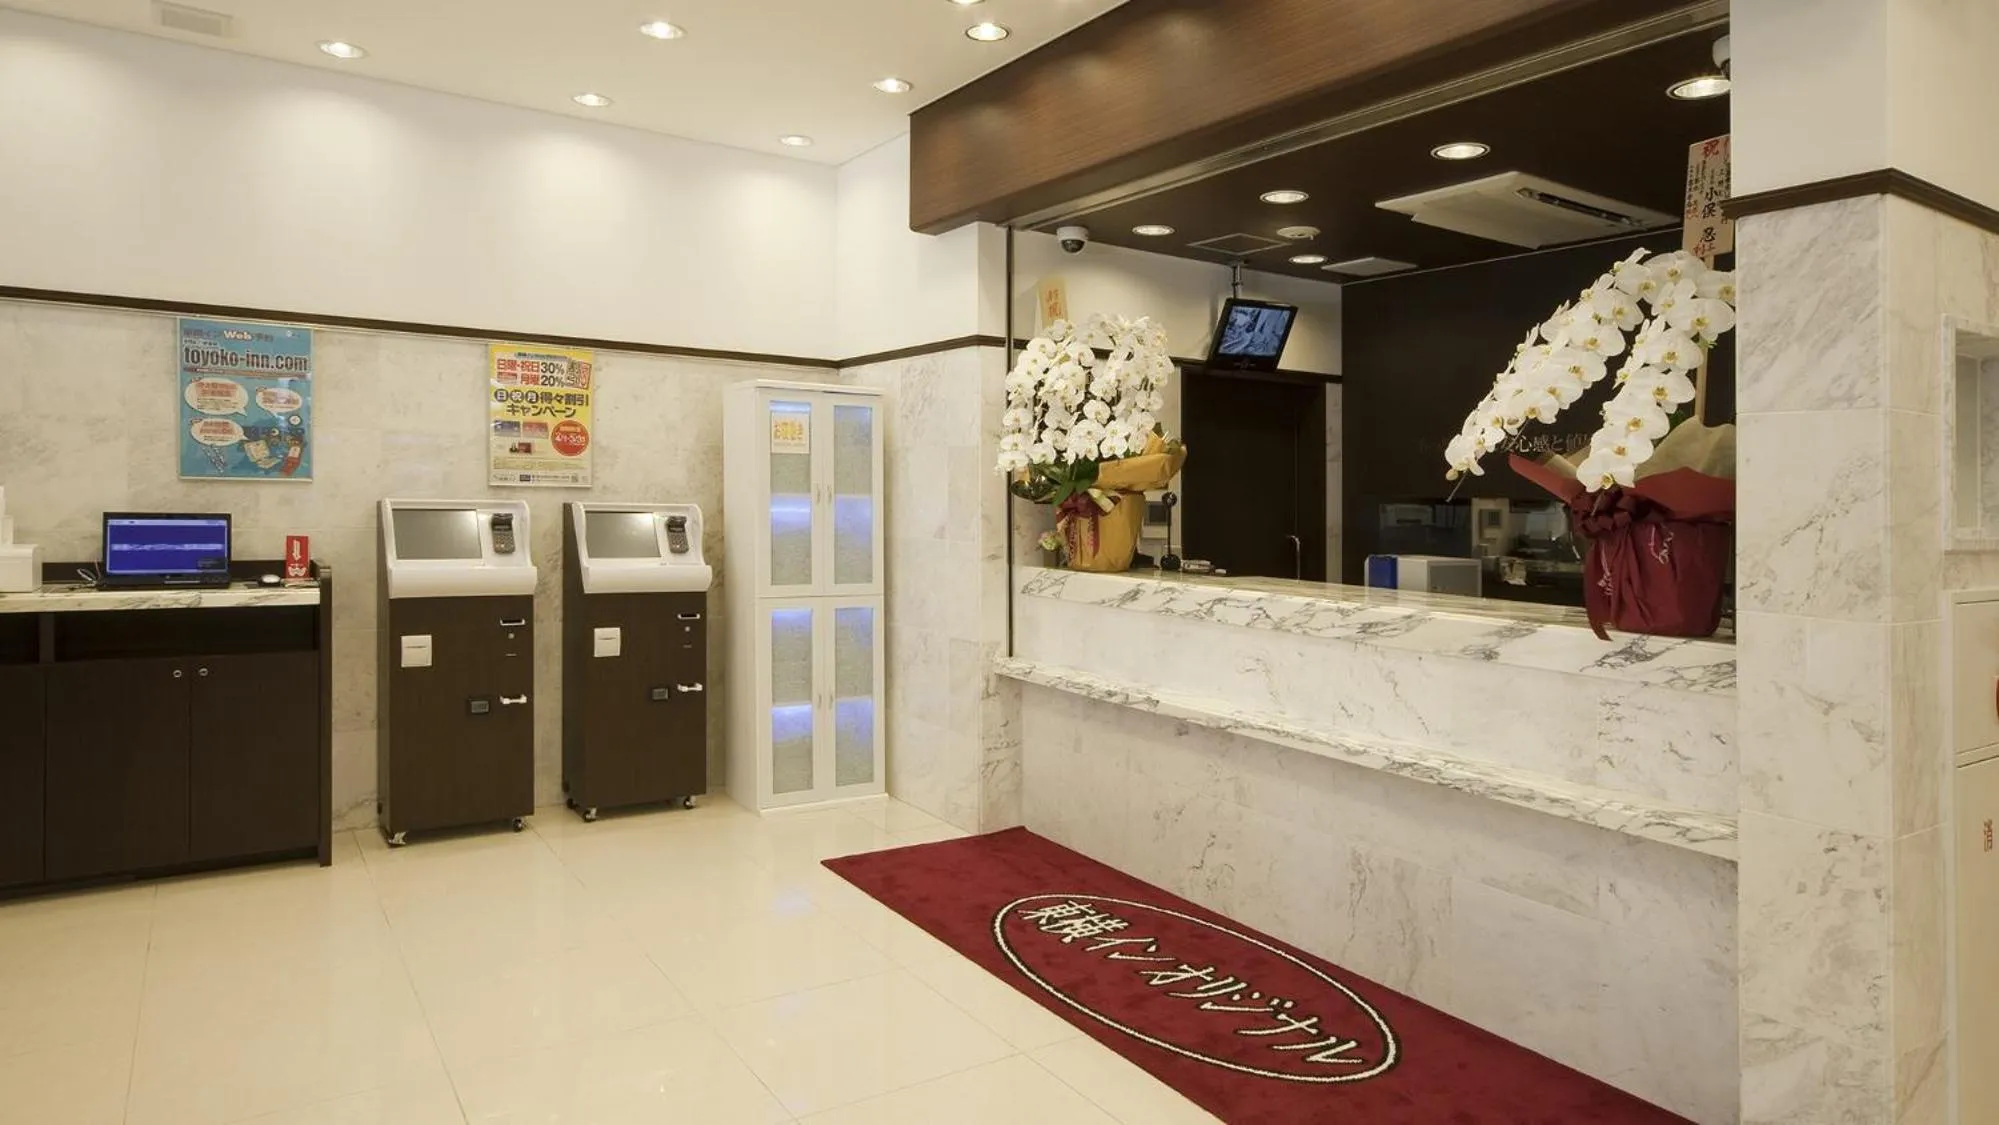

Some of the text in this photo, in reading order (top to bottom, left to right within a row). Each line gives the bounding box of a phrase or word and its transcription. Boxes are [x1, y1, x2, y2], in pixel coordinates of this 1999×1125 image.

[224, 330, 252, 341] Web
[184, 347, 308, 371] toyoko-inn.com
[507, 404, 576, 418] キャンペーン
